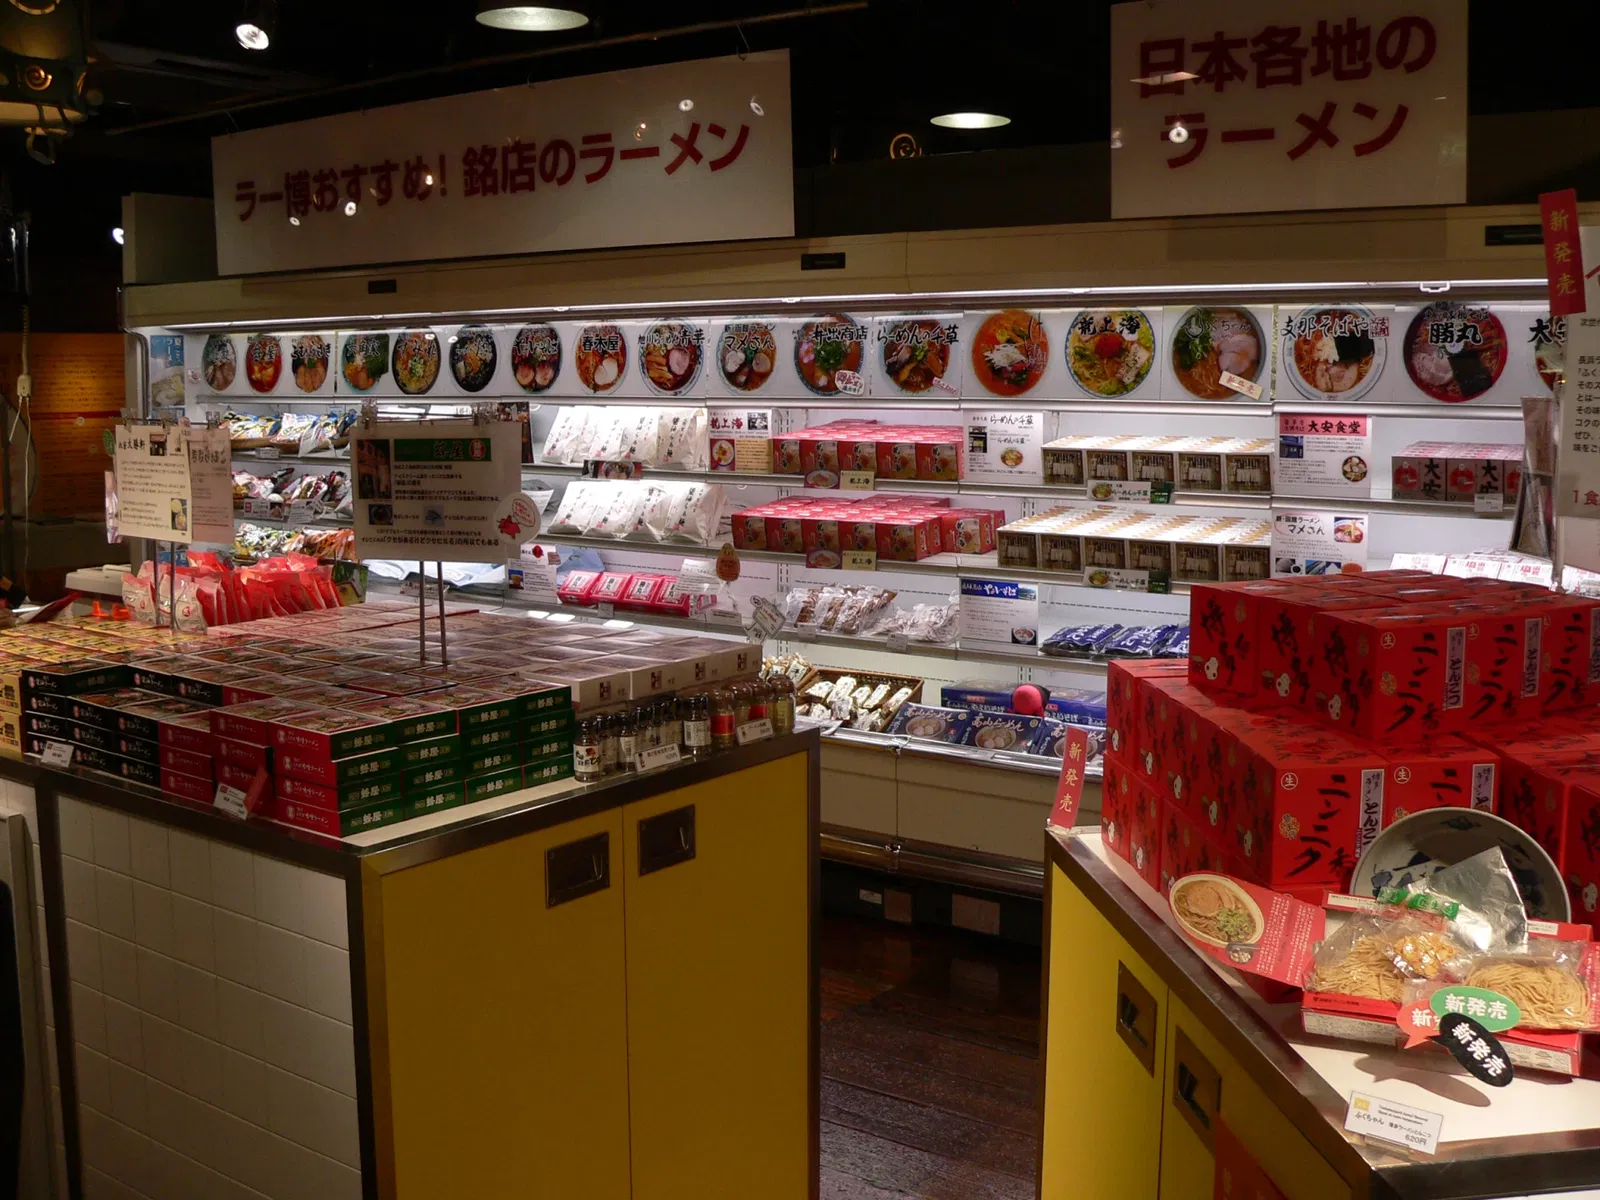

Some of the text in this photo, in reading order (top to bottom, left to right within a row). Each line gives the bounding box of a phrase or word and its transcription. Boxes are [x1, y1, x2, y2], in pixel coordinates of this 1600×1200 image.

[1140, 16, 1437, 98] 日本各地の
[1160, 102, 1409, 169] ラーメン
[463, 122, 750, 198] 銘店のラーメン
[1550, 209, 1577, 297] 新発売
[812, 324, 868, 346] 井出商店
[877, 324, 960, 345] らーめんの千草
[1280, 315, 1370, 337] 支那そばや
[1429, 322, 1482, 344] 勝丸
[583, 335, 619, 352] 春木屋
[725, 335, 776, 351] マメさん
[1308, 420, 1361, 434] 大安食堂
[1421, 459, 1442, 500] 大安
[1287, 524, 1325, 535] マメさん
[1449, 657, 1462, 707] とんこつ
[972, 713, 1024, 732] 高山らーめん
[1058, 742, 1082, 813] 新発売
[1283, 774, 1297, 788] 生
[1395, 768, 1409, 783] 生
[1284, 774, 1350, 878] ニンニク
[1363, 802, 1378, 846] とんこ
[1445, 993, 1508, 1019] 新発売
[1451, 1019, 1506, 1077] 新発売
[1355, 1111, 1385, 1125] ふくちゃん
[1405, 1134, 1427, 1146] 620円
